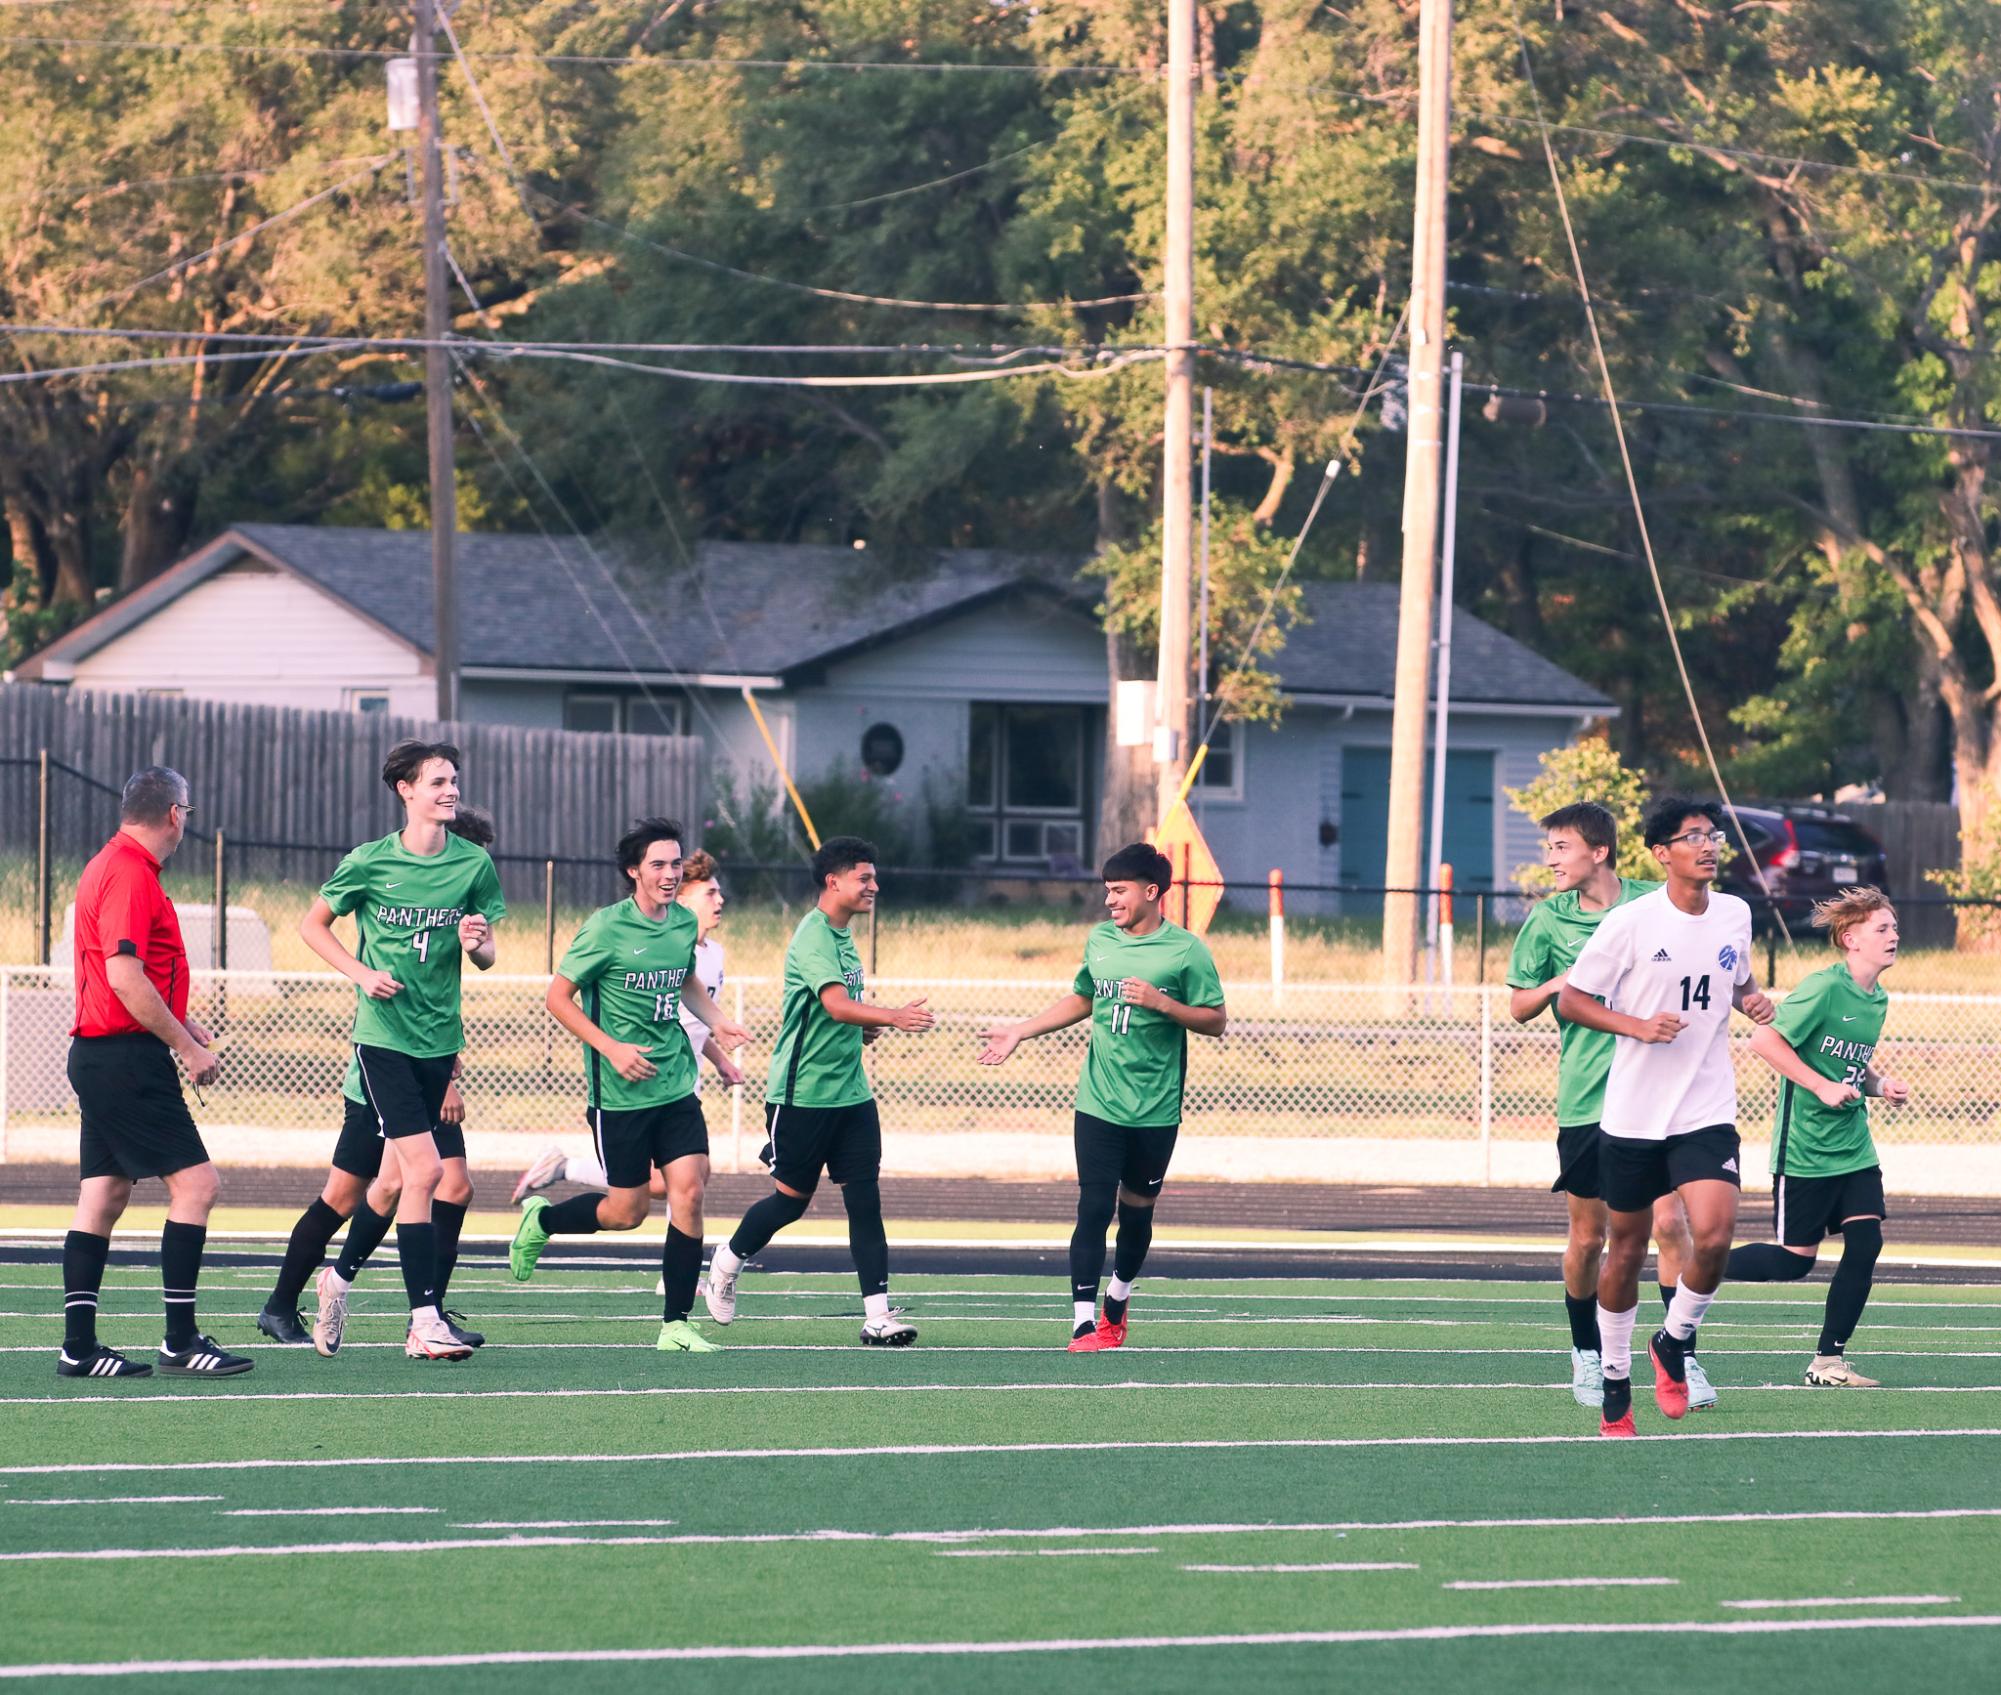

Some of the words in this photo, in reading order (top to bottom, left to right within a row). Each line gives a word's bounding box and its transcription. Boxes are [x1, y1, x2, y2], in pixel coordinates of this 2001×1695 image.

[412, 931, 430, 963] 4
[653, 992, 676, 1022] 16
[1680, 974, 1711, 1011] 14
[1111, 1003, 1132, 1035] 11
